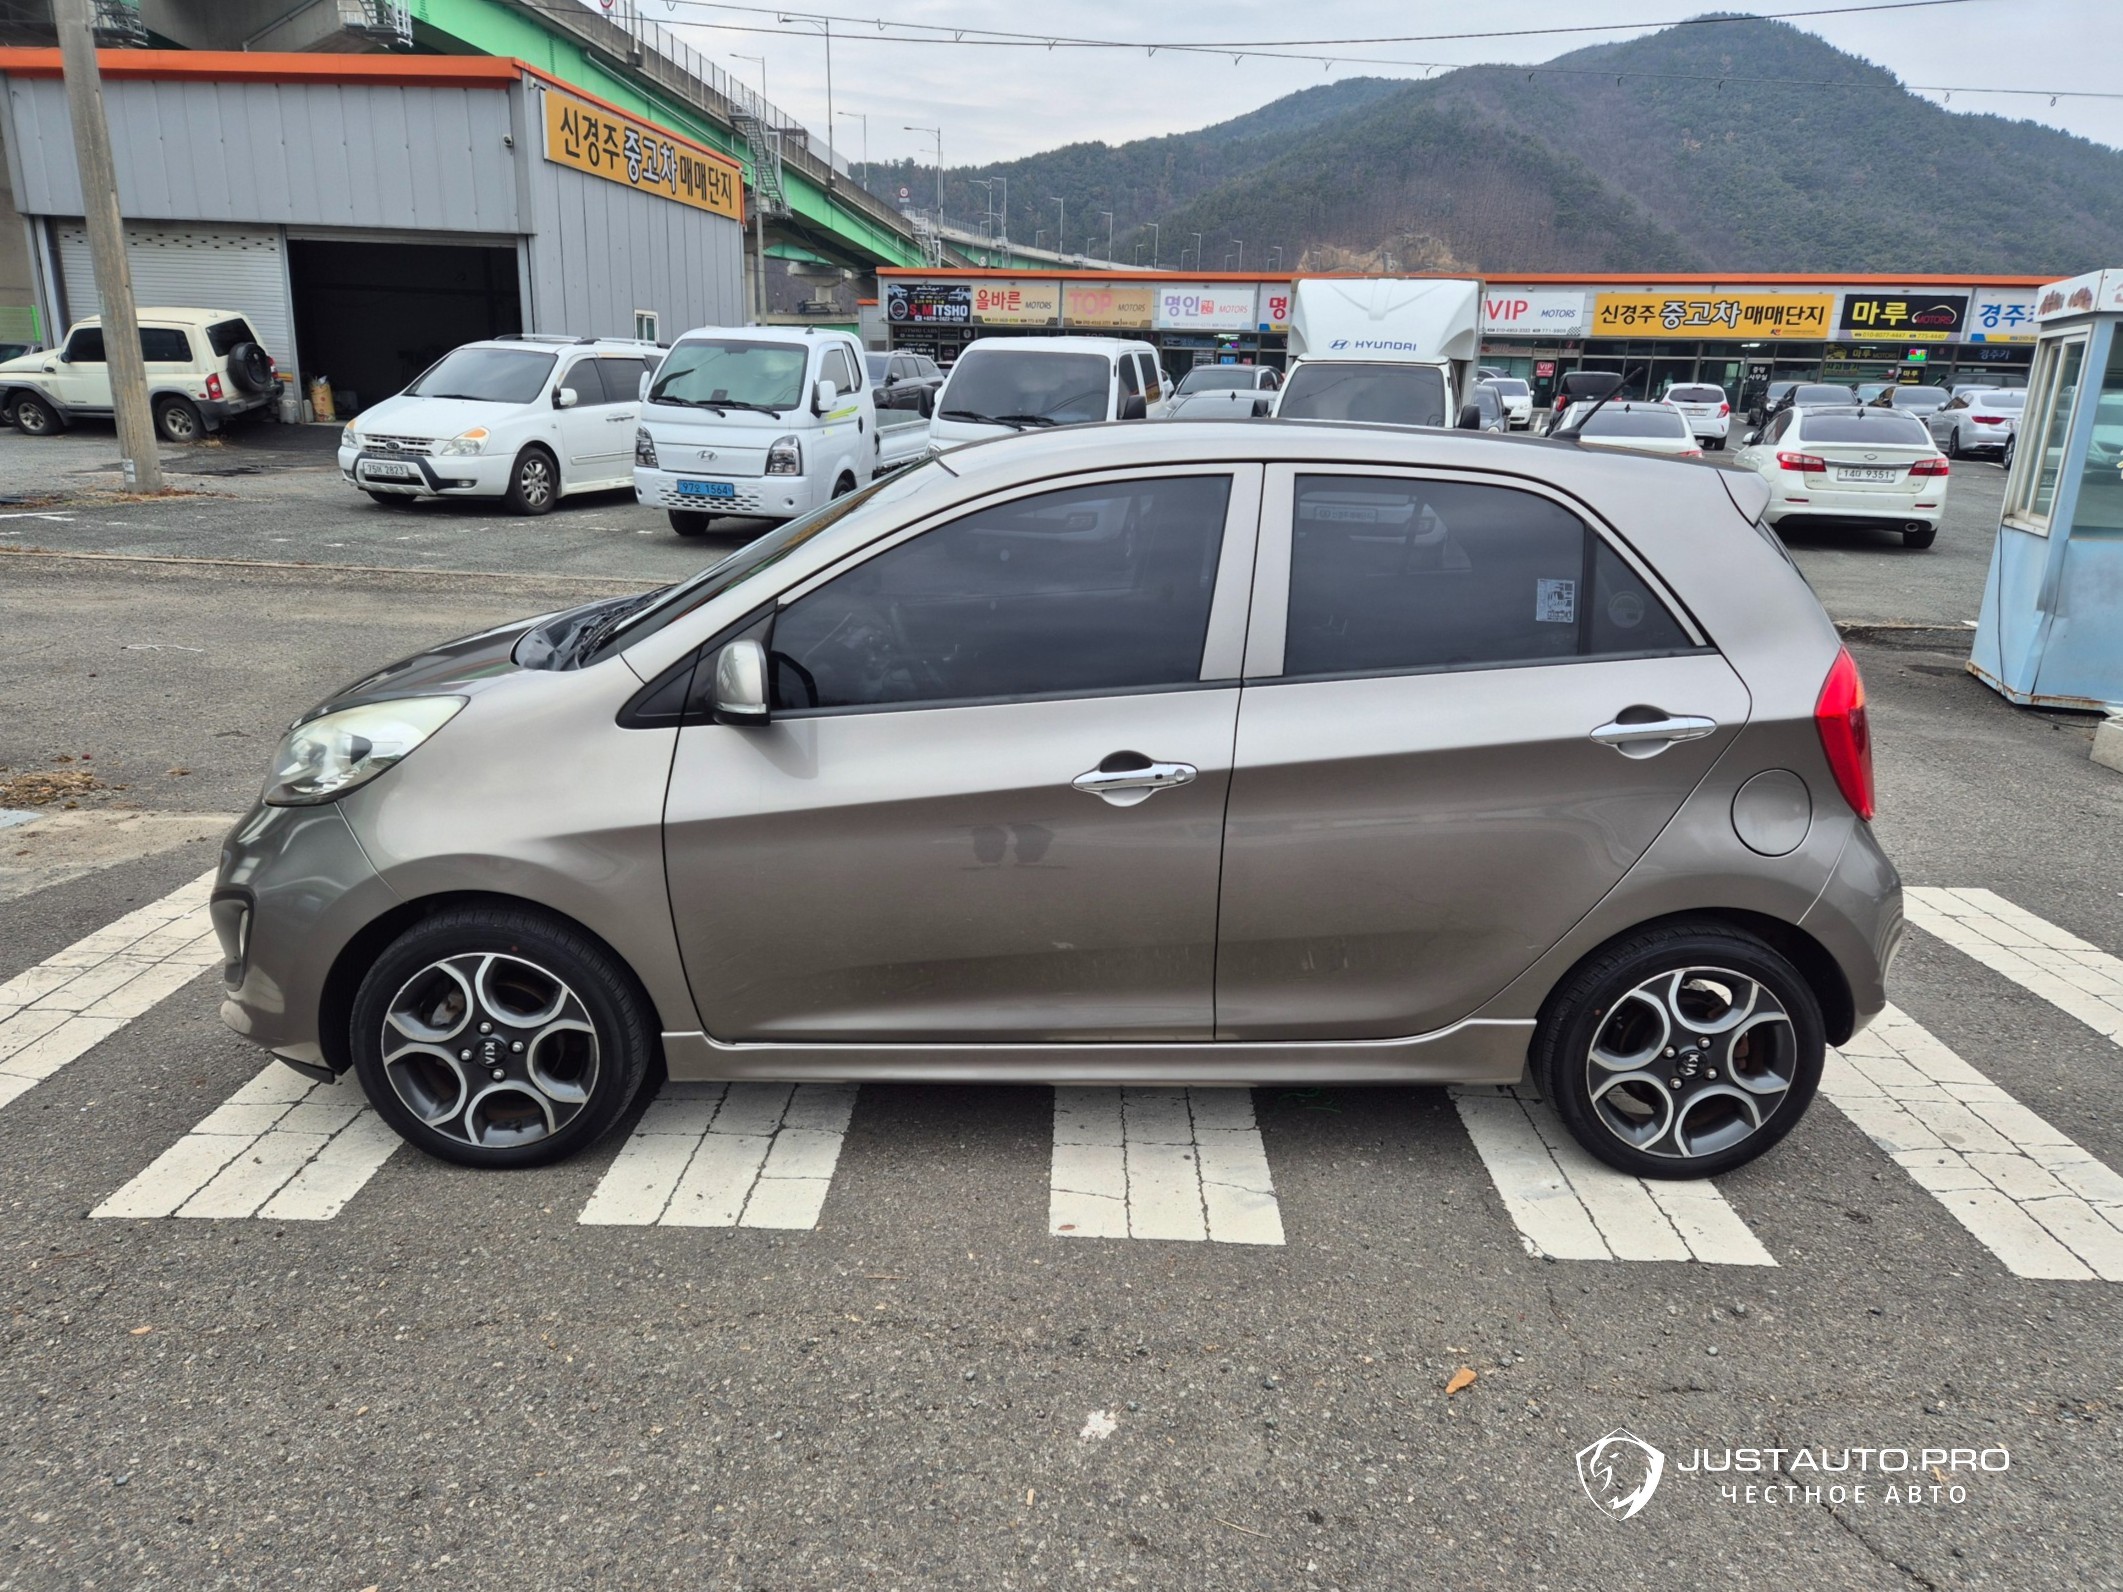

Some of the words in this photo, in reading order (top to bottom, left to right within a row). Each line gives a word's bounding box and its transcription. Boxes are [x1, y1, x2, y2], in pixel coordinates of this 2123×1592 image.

[560, 106, 620, 170] 신경주
[623, 126, 678, 195] 중고차
[679, 155, 733, 209] 매매단지
[975, 289, 1021, 311] 올바른
[1025, 301, 1052, 309] MOTORS
[1068, 291, 1113, 315] TOP
[1117, 303, 1146, 312] MOTORS
[1165, 295, 1199, 317] 명인
[1219, 304, 1248, 314] MOTORS
[1269, 296, 1287, 320] 명
[1486, 299, 1528, 320] VIP
[1540, 309, 1576, 318] MOTORS
[1600, 304, 1656, 325] 신경주
[1659, 300, 1741, 330] 중고차
[1743, 305, 1824, 326] 매매단지
[1852, 301, 1908, 326] 마루
[1916, 314, 1952, 325] MOTORS
[1355, 340, 1417, 351] HYUNDAI
[1866, 470, 1889, 479] 9351
[705, 484, 728, 495] 1564
[484, 1042, 496, 1065] KIA
[1684, 1054, 1699, 1076] KIA
